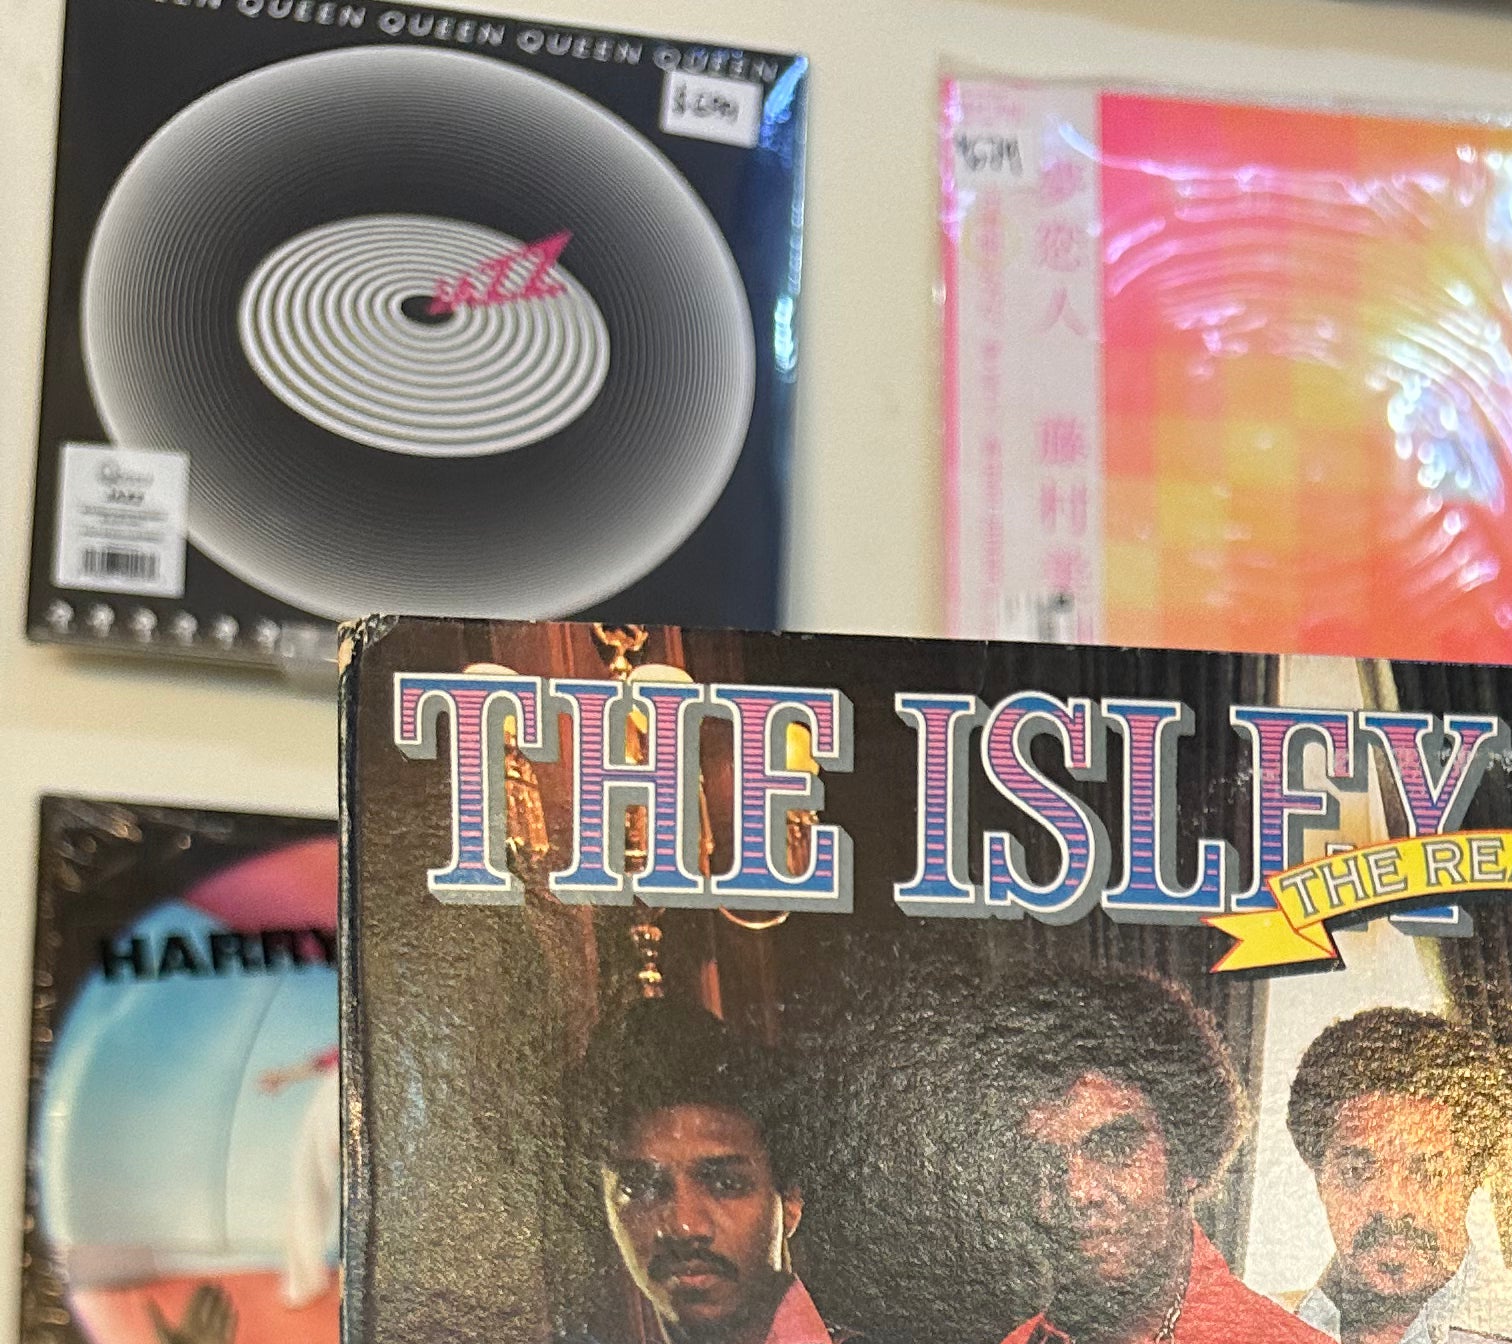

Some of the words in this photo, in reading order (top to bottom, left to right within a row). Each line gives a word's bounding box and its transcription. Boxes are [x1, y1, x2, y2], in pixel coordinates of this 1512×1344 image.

[377, 10, 506, 46] QUEEN
[516, 28, 644, 65] QUEEN
[393, 671, 855, 913] THE
[893, 691, 1512, 939] ISLEY
[1282, 845, 1409, 918] THE
